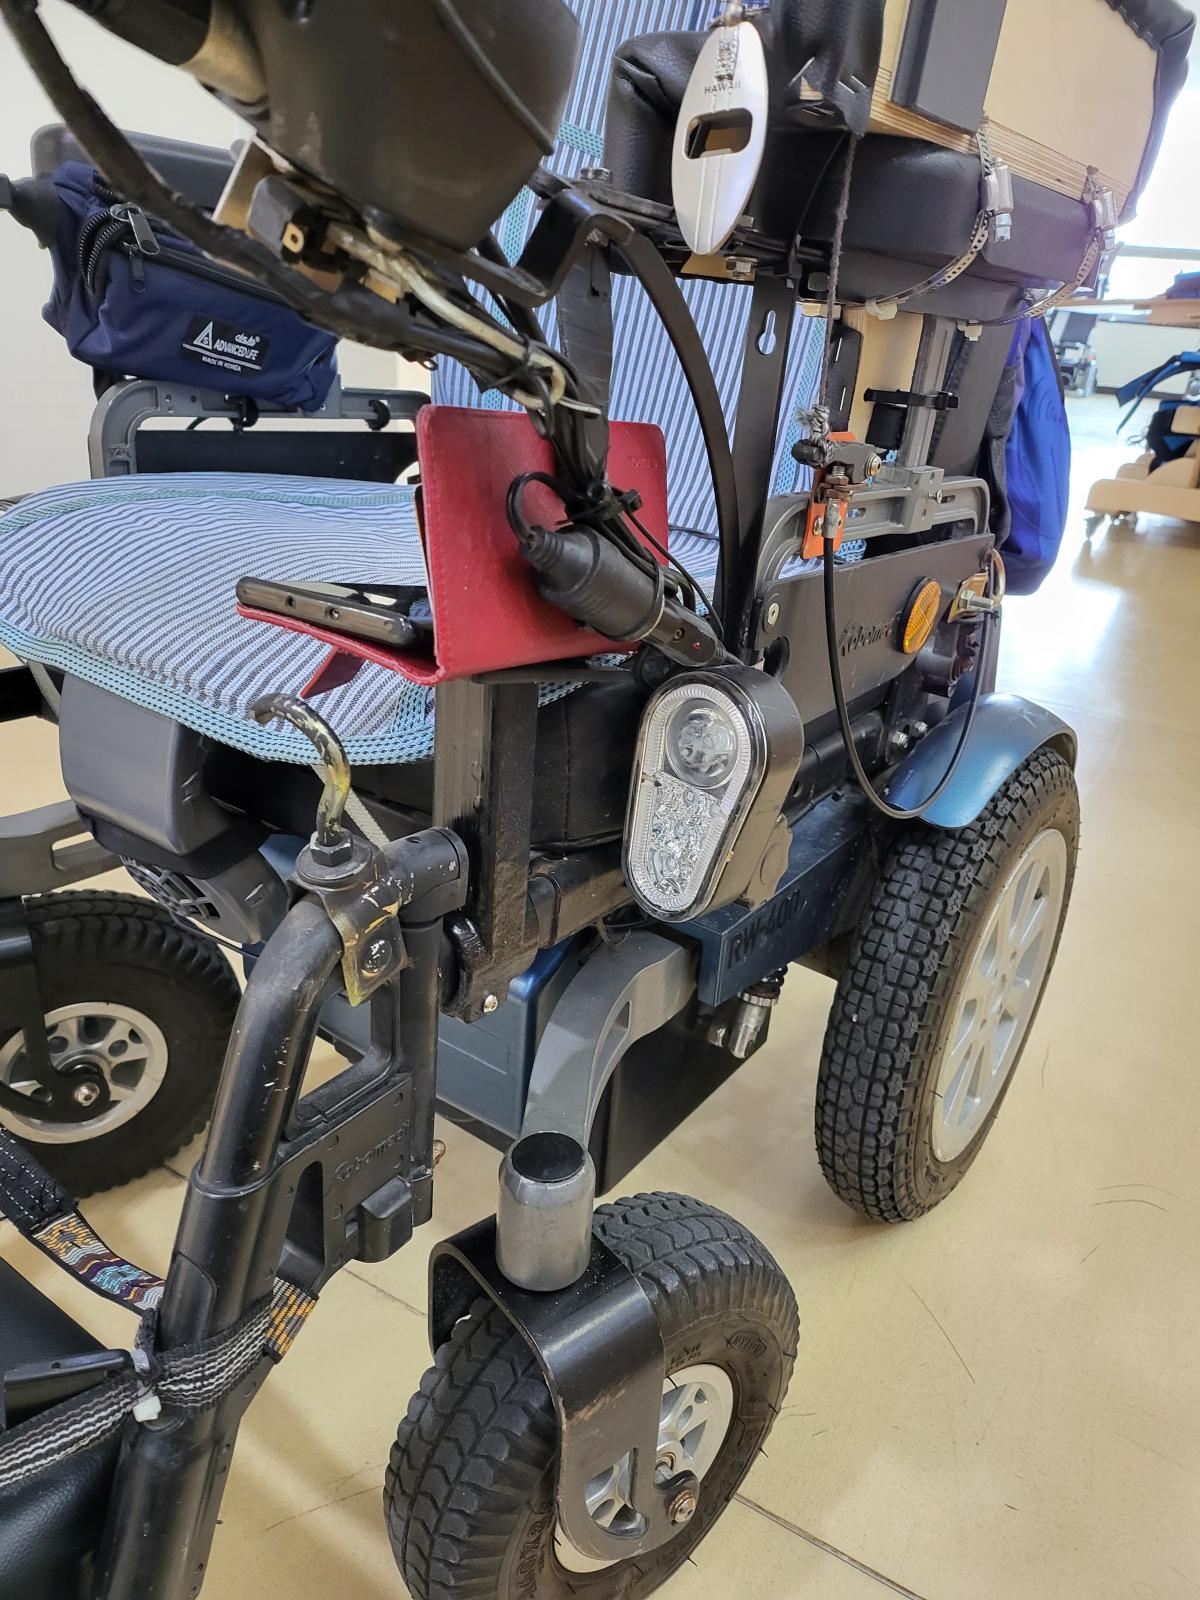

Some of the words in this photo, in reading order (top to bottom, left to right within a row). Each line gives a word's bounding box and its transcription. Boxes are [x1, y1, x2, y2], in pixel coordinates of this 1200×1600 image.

[704, 80, 741, 94] HAWAII
[202, 355, 217, 366] MADE
[224, 361, 241, 372] KOREA
